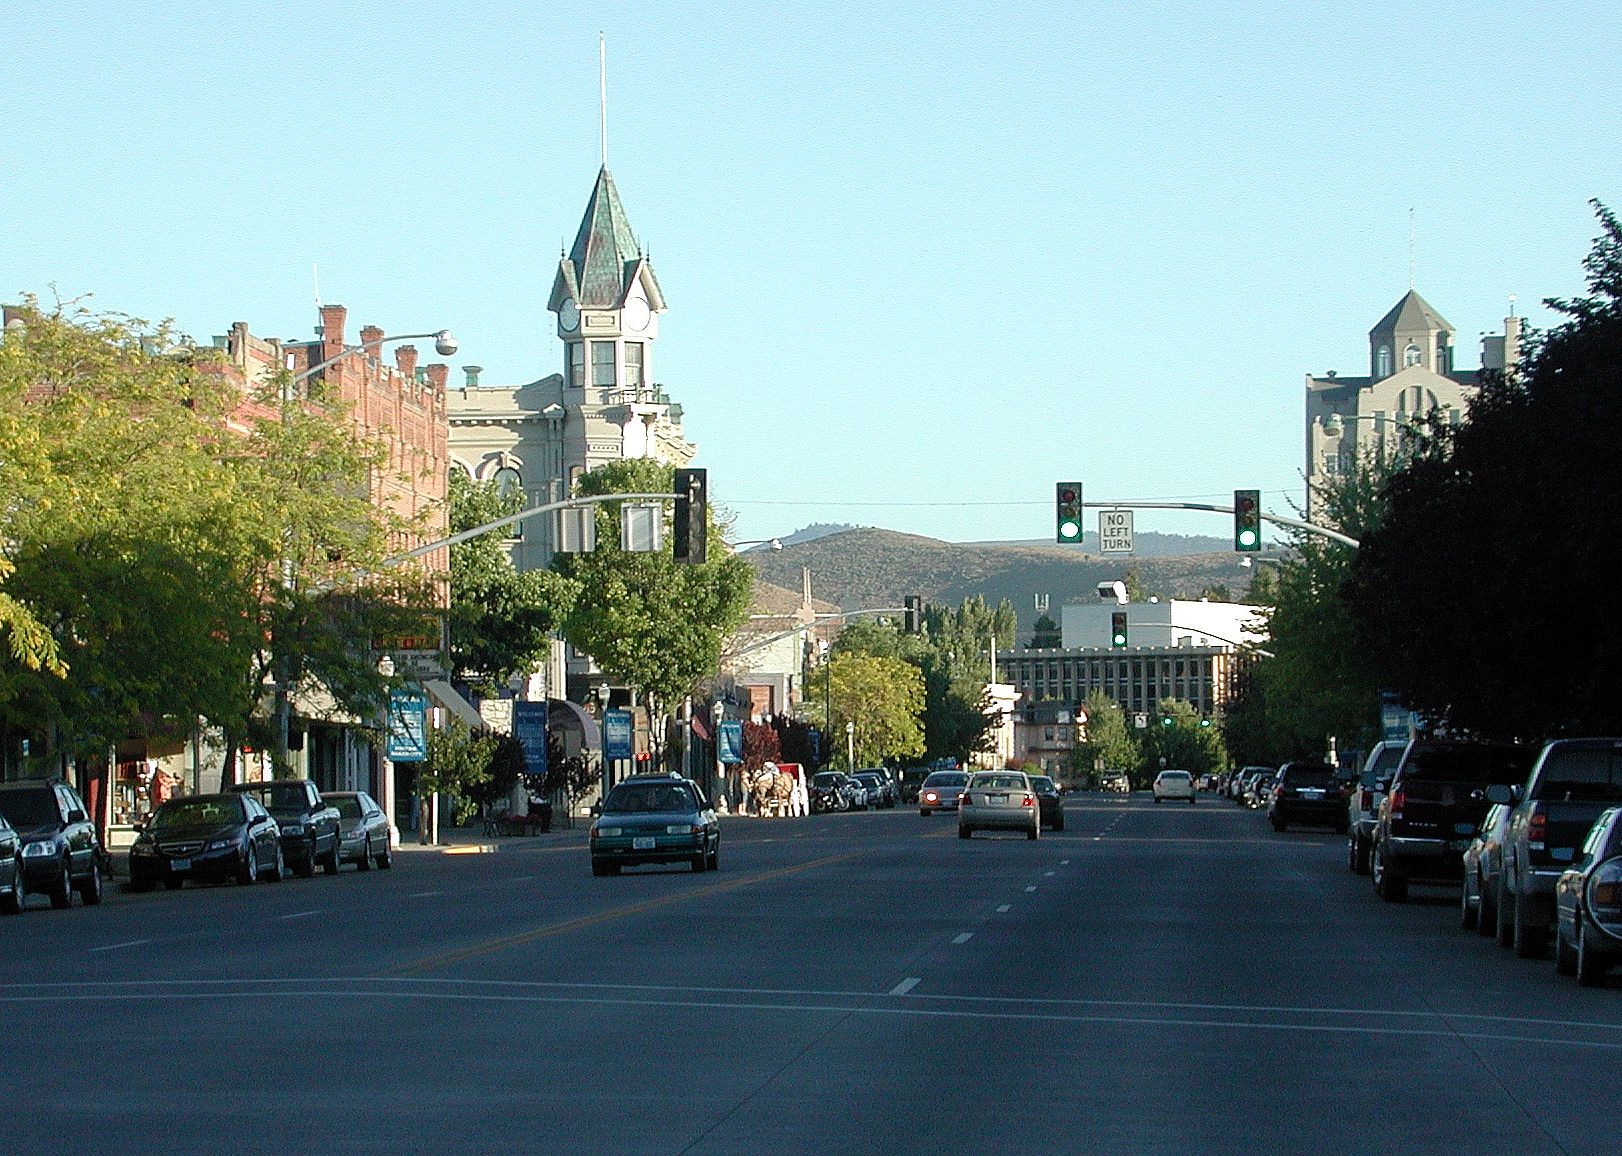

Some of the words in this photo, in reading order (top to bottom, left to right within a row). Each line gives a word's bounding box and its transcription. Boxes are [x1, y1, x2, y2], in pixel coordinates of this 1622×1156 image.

[1107, 514, 1124, 525] NO
[1103, 527, 1129, 537] LEFT
[1103, 539, 1131, 550] TURN
